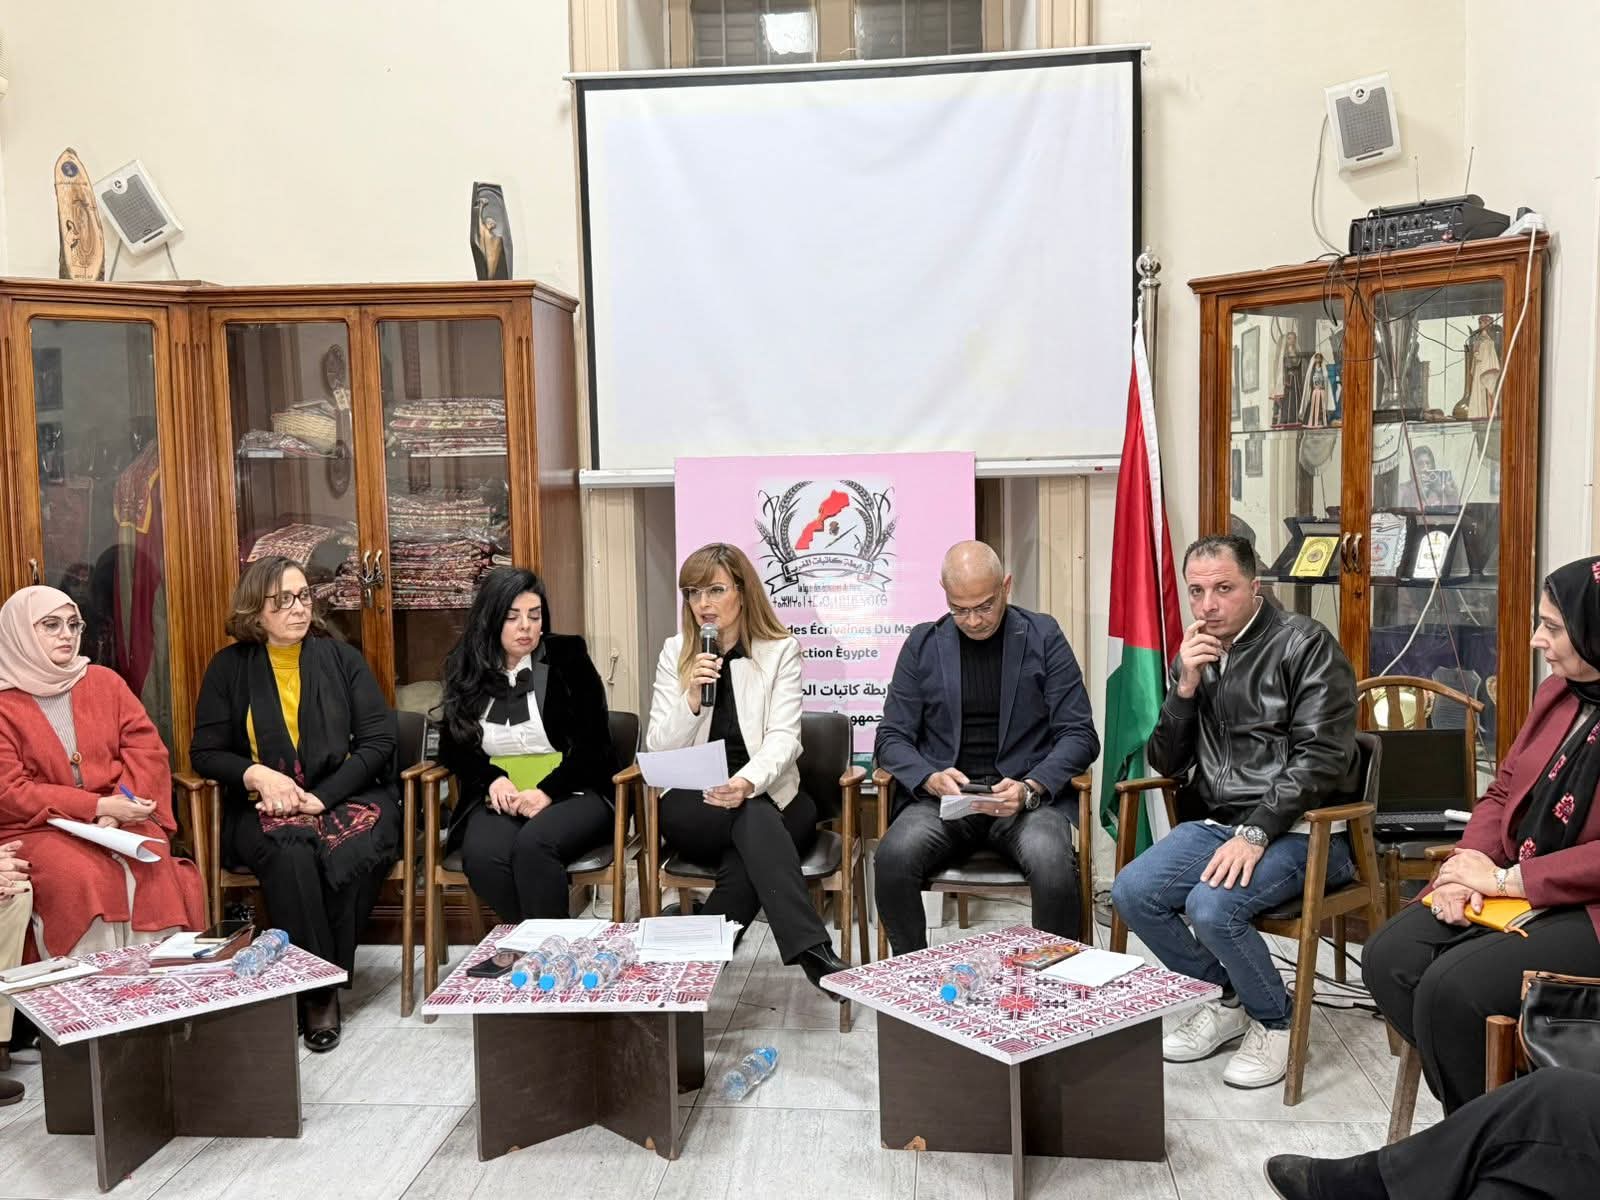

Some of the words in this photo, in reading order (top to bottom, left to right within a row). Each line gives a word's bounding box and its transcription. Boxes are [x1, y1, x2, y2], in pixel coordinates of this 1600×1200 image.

[875, 624, 891, 634] Du
[895, 624, 912, 634] Ma
[802, 647, 833, 658] ction
[801, 684, 816, 696] الم
[820, 684, 860, 699] كاتبات
[863, 683, 887, 698] بطة
